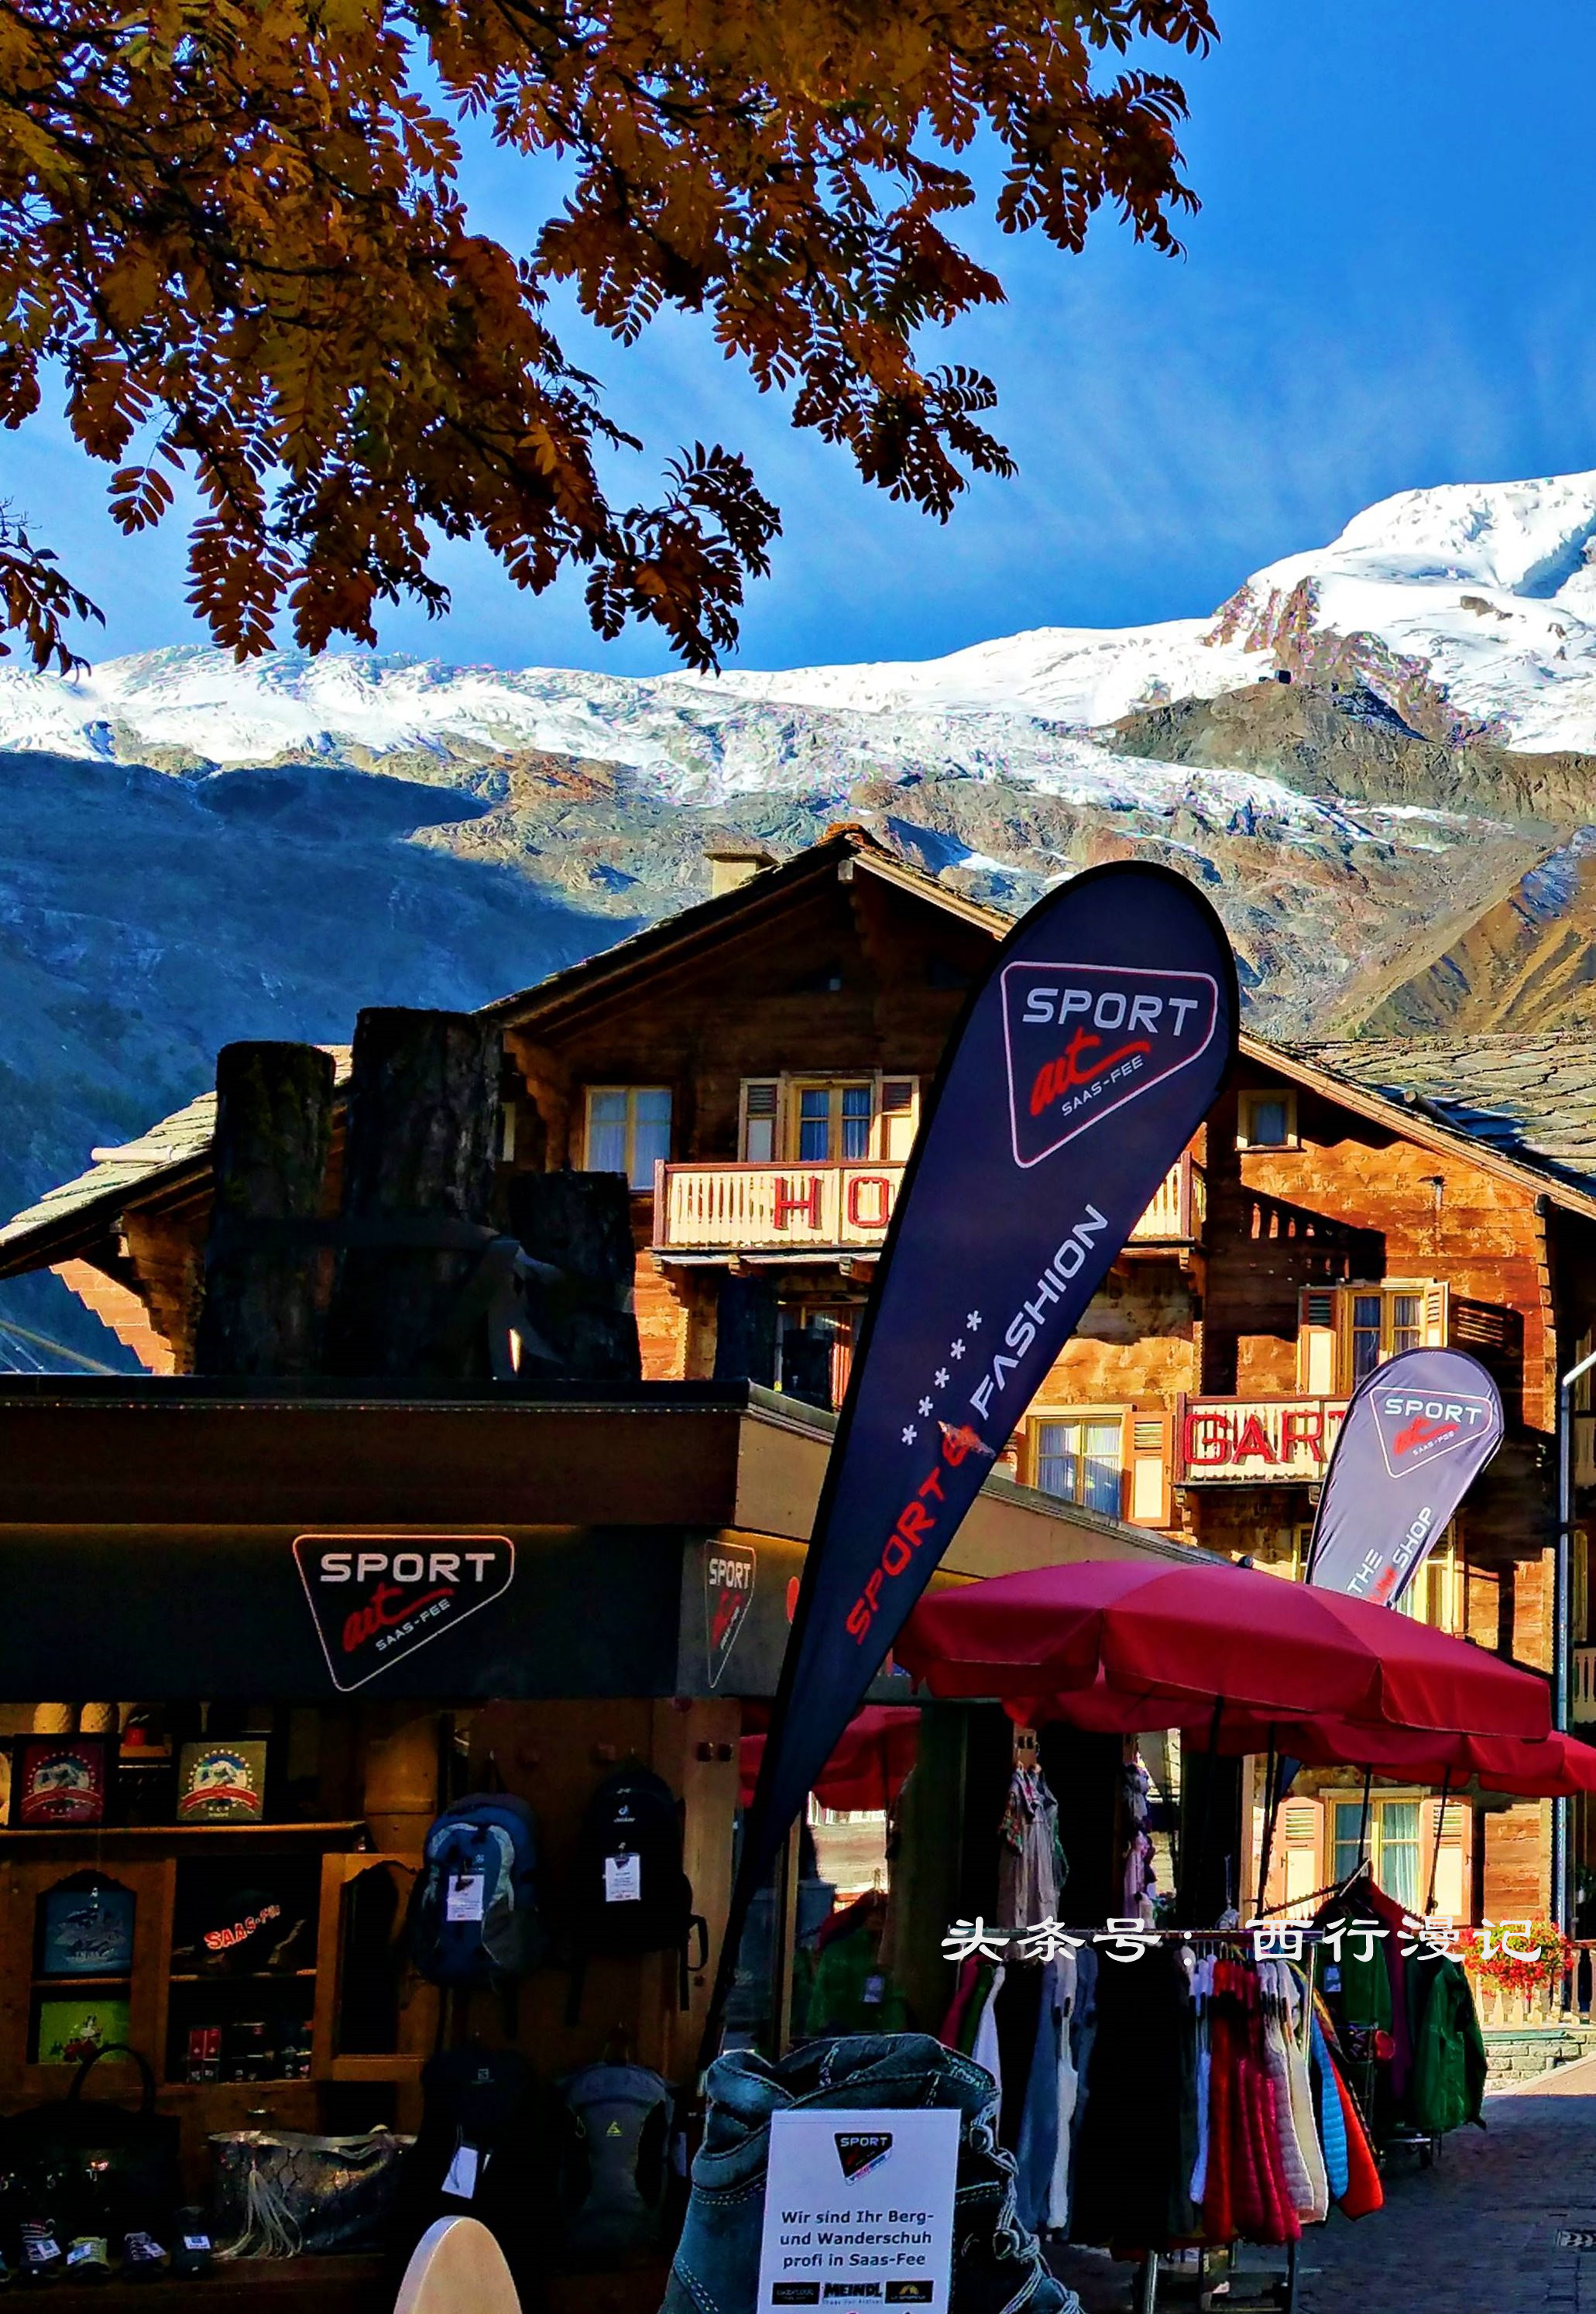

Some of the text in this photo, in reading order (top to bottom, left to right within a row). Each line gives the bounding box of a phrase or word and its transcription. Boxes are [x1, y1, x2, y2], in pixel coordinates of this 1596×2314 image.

[1022, 987, 1198, 1036] SPORT
[1062, 1055, 1145, 1116] SAAS-FEE
[846, 1470, 946, 1645] SPORT
[970, 1203, 1109, 1420] FASHION
[1385, 1399, 1482, 1425] SPORT
[1392, 1506, 1432, 1568] SHOP
[321, 1554, 496, 1582] SPORT
[709, 1558, 751, 1589] SPORT
[1347, 1549, 1384, 1594] THE
[376, 1598, 451, 1651] SAAS-FEE
[840, 2137, 888, 2147] SPORT
[781, 2210, 934, 2225] Wir sind Ihr Berg-
[780, 2231, 932, 2245] und Wanderschuh
[783, 2253, 925, 2270] profi in Saas-Fee
